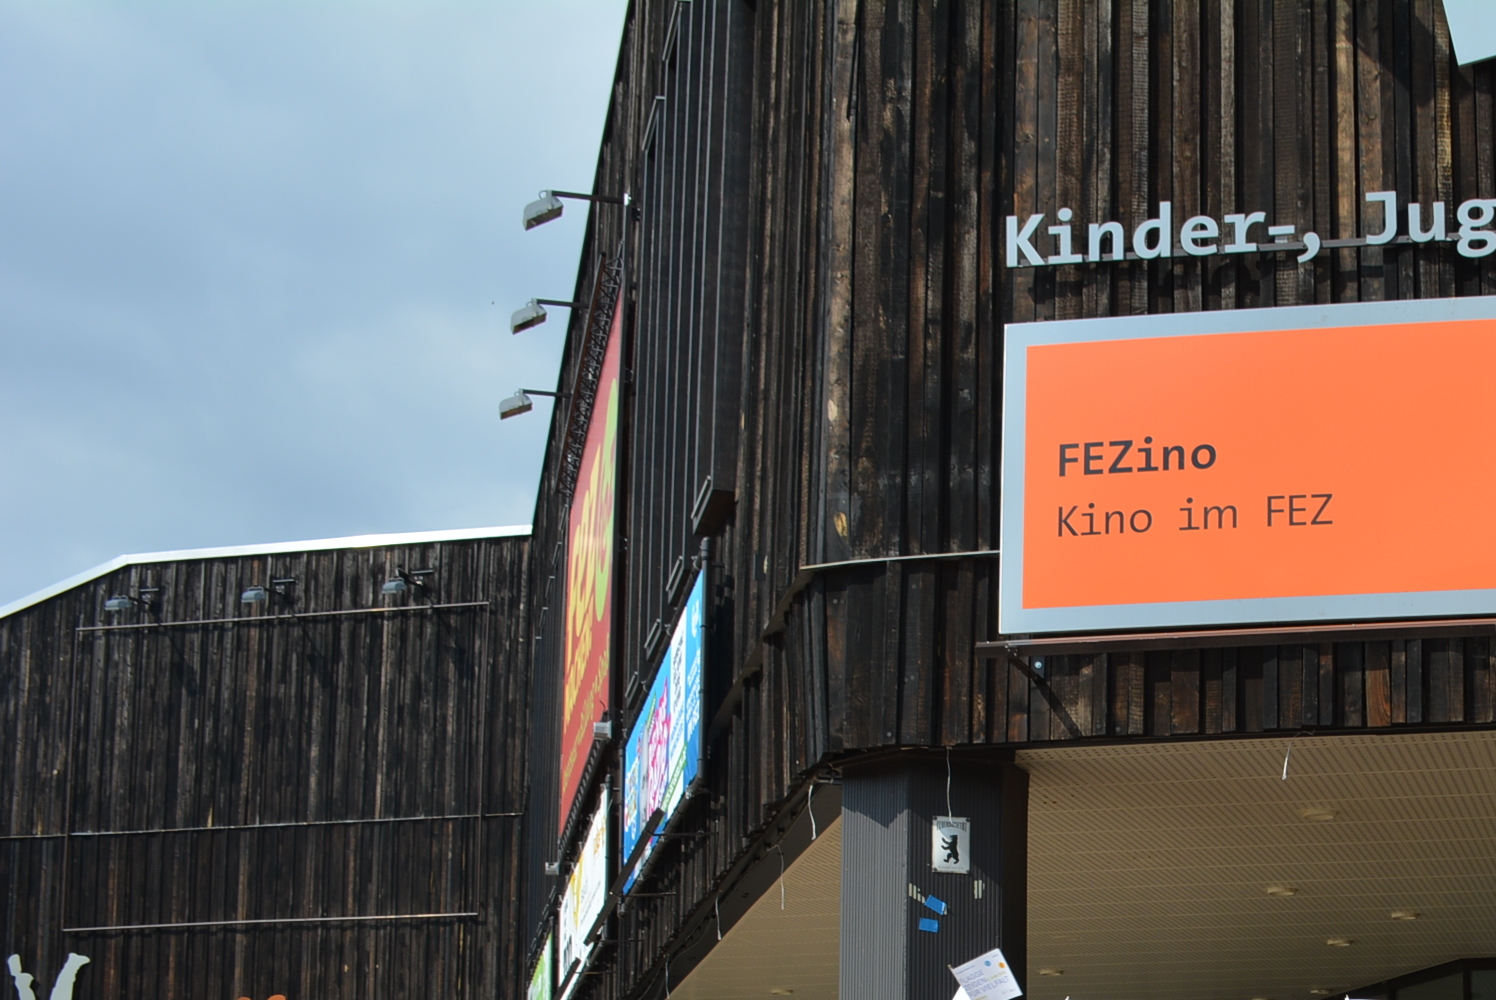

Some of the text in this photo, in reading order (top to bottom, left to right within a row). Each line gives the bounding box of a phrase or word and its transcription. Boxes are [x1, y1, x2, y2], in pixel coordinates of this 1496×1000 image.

[1007, 202, 1320, 264] Kinder-,
[1059, 436, 1216, 477] FEZino
[1058, 493, 1333, 537] Kino im FEZ
